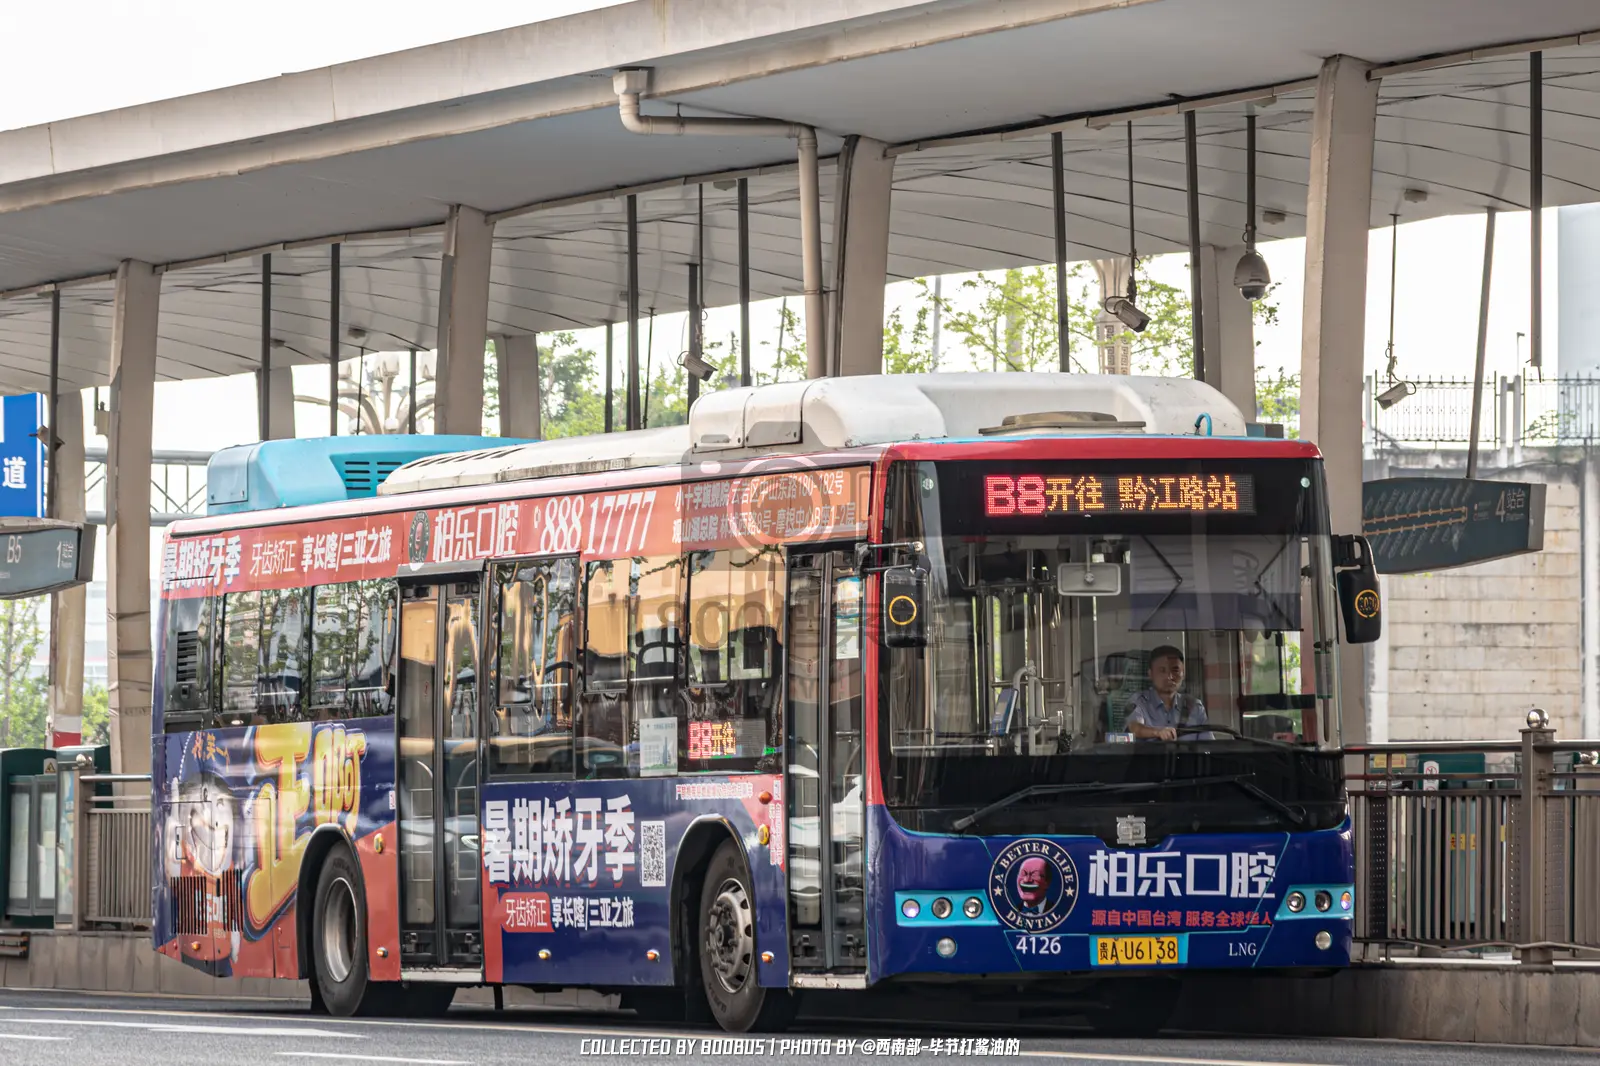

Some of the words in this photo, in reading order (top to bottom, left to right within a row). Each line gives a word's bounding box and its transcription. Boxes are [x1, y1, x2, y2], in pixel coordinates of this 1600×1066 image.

[2, 456, 27, 489] 道
[986, 476, 1046, 514] B8
[1119, 476, 1237, 510] 黔江路站
[1495, 490, 1506, 523] 4
[433, 503, 519, 562] 柏乐口腔
[7, 535, 22, 564] B5
[250, 540, 297, 577] 牙齿矫正
[301, 526, 392, 571] 享长隆/三亚之旅
[484, 795, 635, 886] 暑期矫牙季
[994, 873, 1004, 883] A
[1000, 842, 1050, 869] BETTER
[1053, 852, 1074, 883] LIFE
[1089, 850, 1276, 898] 柏乐口腔
[505, 899, 548, 927] 牙齿矫正
[551, 896, 634, 930] 享长隆/三亚之旅
[1006, 910, 1061, 929] DENTAL
[1091, 910, 1182, 926] 源自中国台湾
[1186, 910, 1273, 928] 服务全球华人
[1016, 936, 1062, 955] 4126
[1228, 942, 1257, 957] LNG
